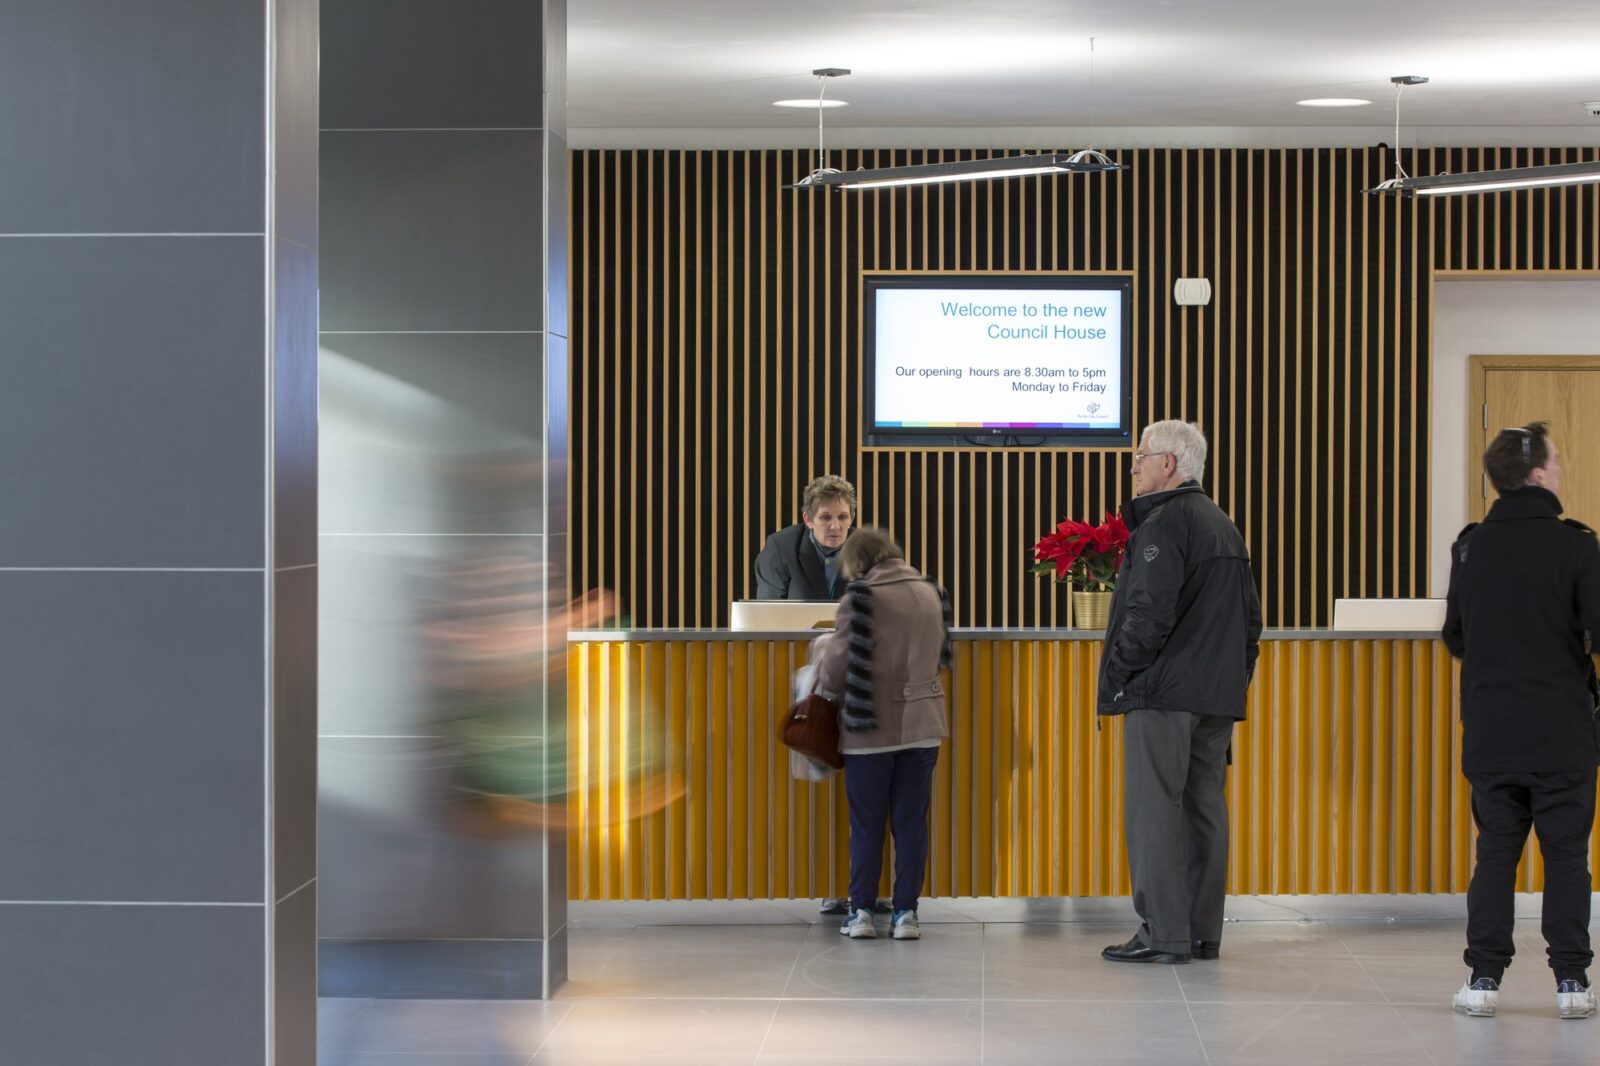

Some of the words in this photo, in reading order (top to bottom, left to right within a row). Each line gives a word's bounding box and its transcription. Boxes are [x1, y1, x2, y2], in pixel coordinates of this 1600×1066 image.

[941, 302, 1017, 317] Welcome
[1023, 303, 1037, 317] to
[1043, 303, 1067, 317] the
[1074, 306, 1106, 317] new
[987, 324, 1048, 339] Council
[1054, 325, 1106, 339] House
[895, 366, 916, 377] Our
[919, 366, 962, 378] opening
[969, 366, 999, 377] hours
[1003, 369, 1021, 377] are
[1024, 367, 1065, 378] 8.30am
[1069, 367, 1079, 378] to
[1082, 367, 1106, 380] 5pm
[1012, 382, 1055, 393] Monday
[1059, 382, 1069, 392] to
[1072, 382, 1106, 394] Friday
